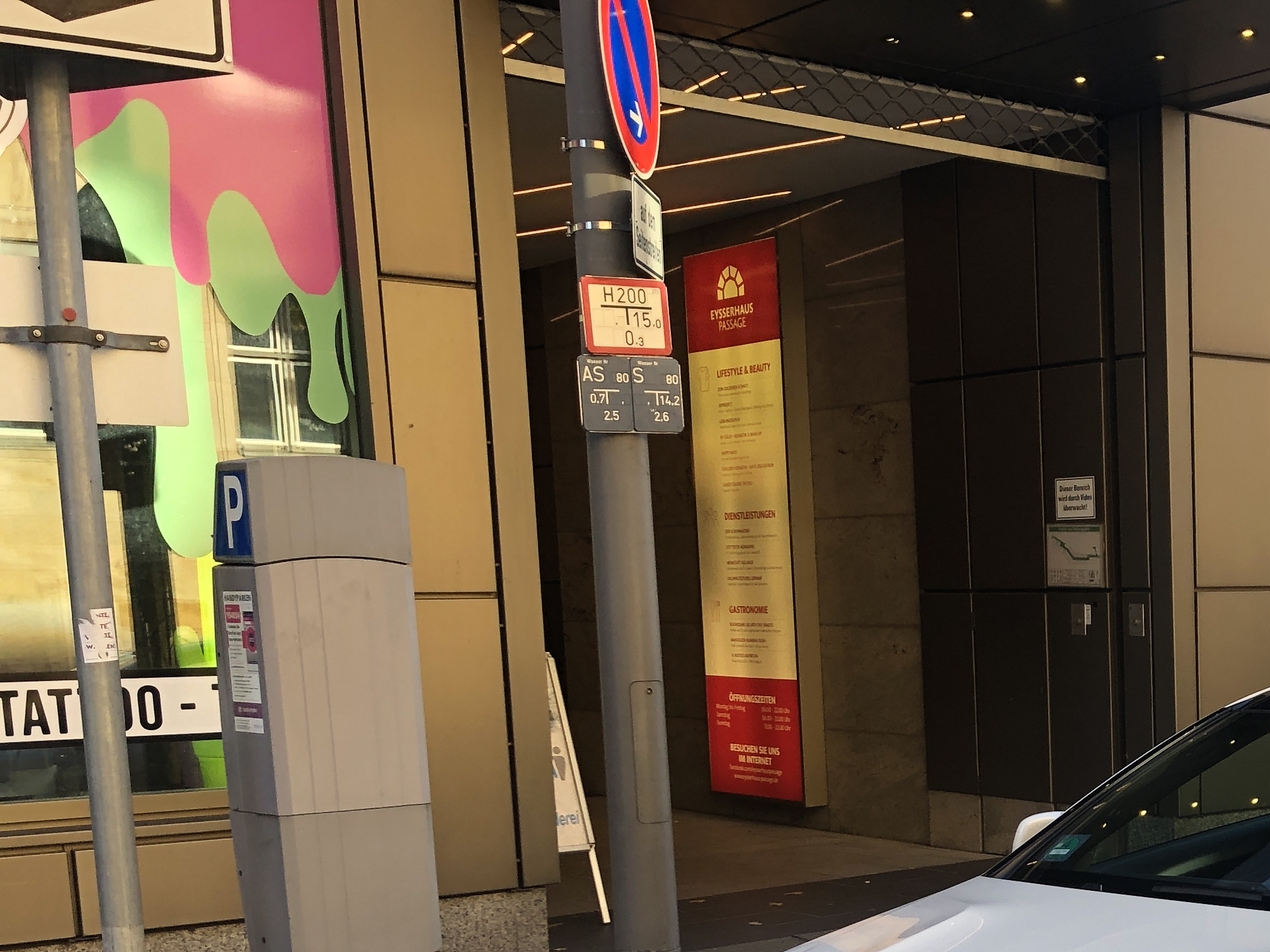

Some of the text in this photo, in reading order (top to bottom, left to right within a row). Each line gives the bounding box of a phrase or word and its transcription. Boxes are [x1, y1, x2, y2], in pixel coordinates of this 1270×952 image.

[710, 302, 754, 320] EYSSERHAUS
[718, 316, 747, 331] PASSAGE
[582, 365, 630, 383] AS 80
[632, 367, 679, 385] S 80
[716, 362, 771, 378] LIFESTYLE & BEAUTY
[659, 395, 681, 406] 14.2
[603, 410, 620, 421] 2.5
[654, 411, 670, 422] 2.6
[1080, 493, 1093, 501] Video
[724, 510, 776, 521] DIENSTLEISTUNGEN
[729, 605, 769, 614] GASTRONOMIE
[728, 691, 776, 705] ÖFFNUNGSZEITEN
[0, 685, 163, 736] TATO
[729, 743, 780, 756] BESUCHEN SIE UNS
[738, 754, 772, 766] IM INTERNET
